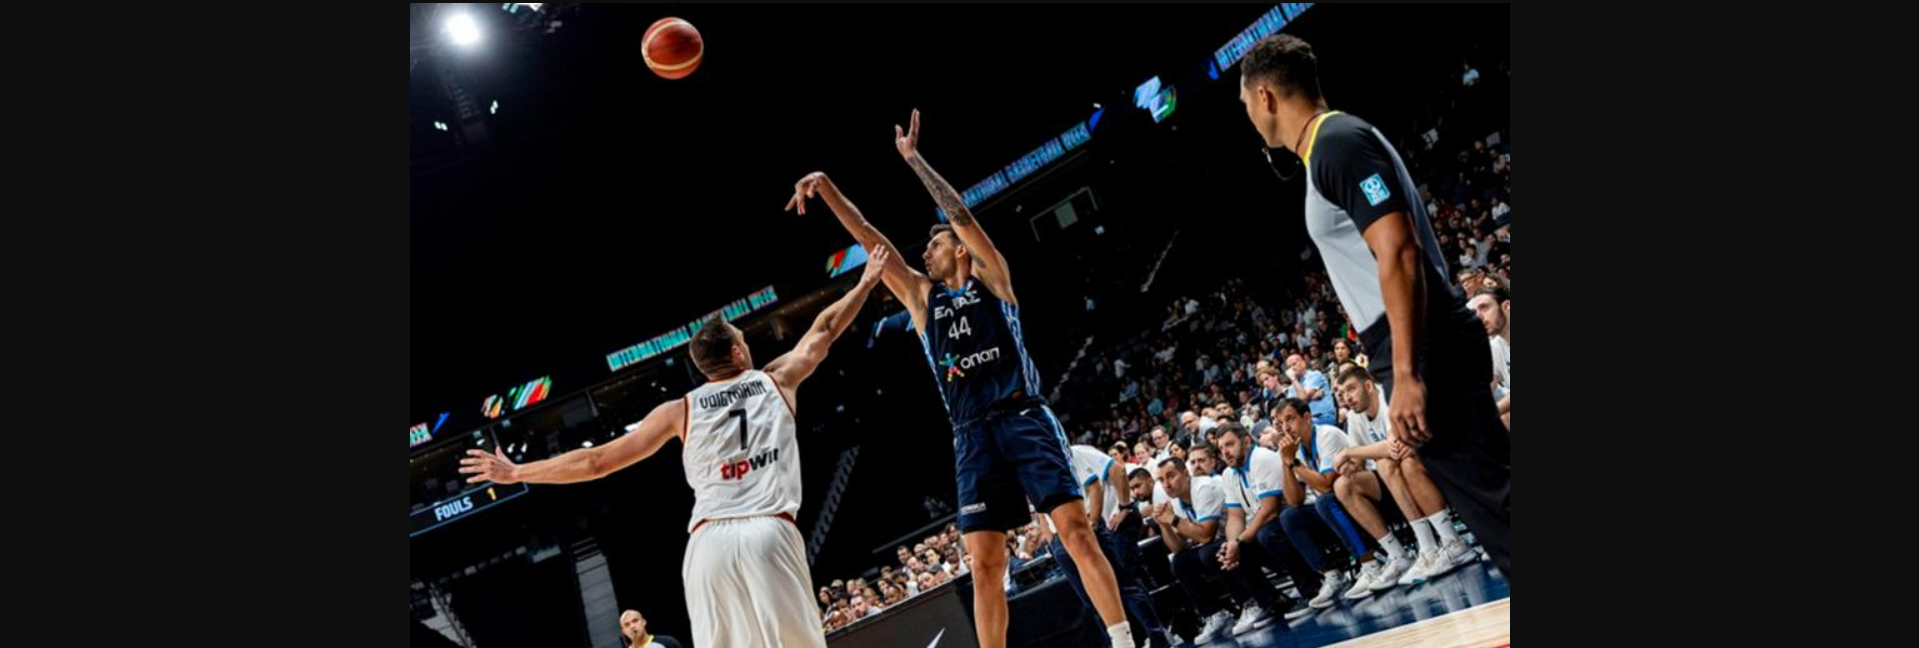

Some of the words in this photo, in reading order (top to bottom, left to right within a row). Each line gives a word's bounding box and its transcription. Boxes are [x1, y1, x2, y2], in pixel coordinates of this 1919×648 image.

[606, 325, 691, 373] INTERNATIONAL
[748, 285, 779, 311] WEEK
[948, 315, 972, 340] 44
[729, 408, 749, 451] 7
[434, 496, 474, 521] FOULS
[486, 487, 497, 501] 1
